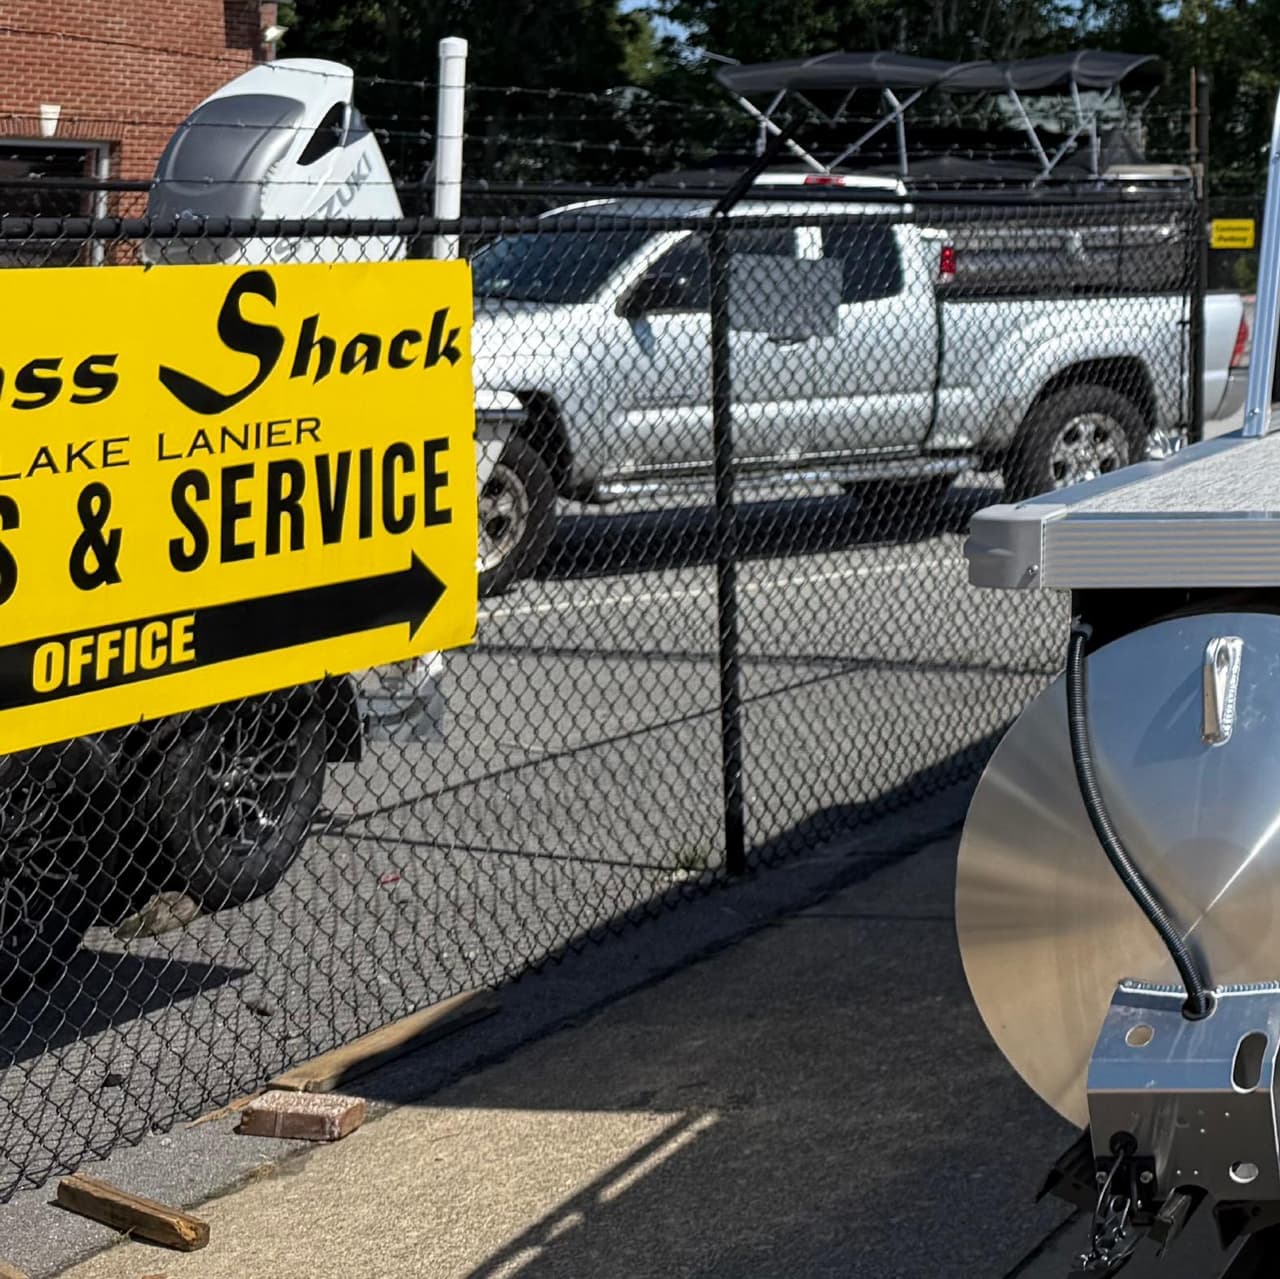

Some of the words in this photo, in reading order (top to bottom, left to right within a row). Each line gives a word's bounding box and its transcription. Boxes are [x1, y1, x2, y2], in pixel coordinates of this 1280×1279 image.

[0, 353, 120, 411] ss
[158, 269, 463, 415] Shack
[157, 417, 322, 461] LANIER
[69, 481, 123, 591] &
[169, 436, 453, 573] SERVICE
[32, 614, 197, 694] OFFICE
